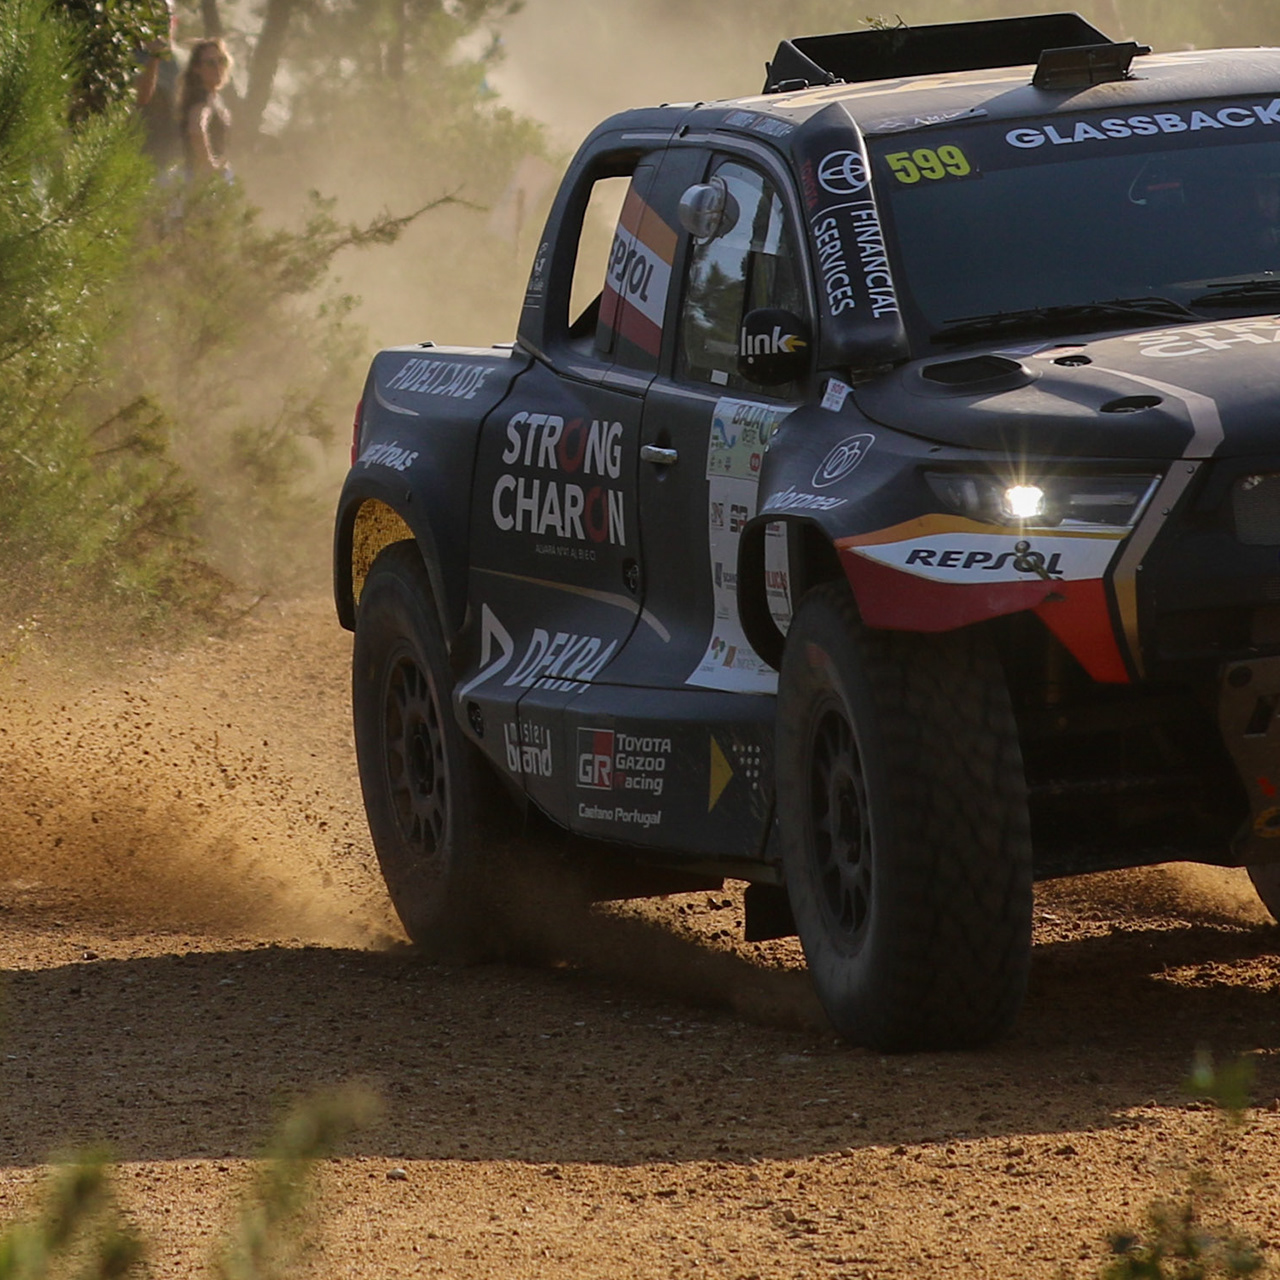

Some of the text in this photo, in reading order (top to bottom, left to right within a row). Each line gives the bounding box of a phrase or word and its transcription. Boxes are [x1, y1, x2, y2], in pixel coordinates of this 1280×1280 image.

[885, 144, 971, 184] 599
[814, 217, 855, 317] SERVICES
[850, 209, 899, 318] FINANCIAL
[741, 325, 794, 364] link
[385, 358, 495, 399] FIDELIDADE
[502, 411, 623, 479] STRONG
[492, 474, 625, 546] CHARON
[905, 549, 1064, 574] REPSOL
[503, 628, 617, 693] DEKRA
[504, 723, 552, 777] brand
[616, 734, 671, 753] TOYOTA
[616, 753, 665, 771] GAZOO
[579, 753, 612, 786] GR
[615, 772, 664, 795] Racing
[578, 803, 661, 828] Caetano Portugal
